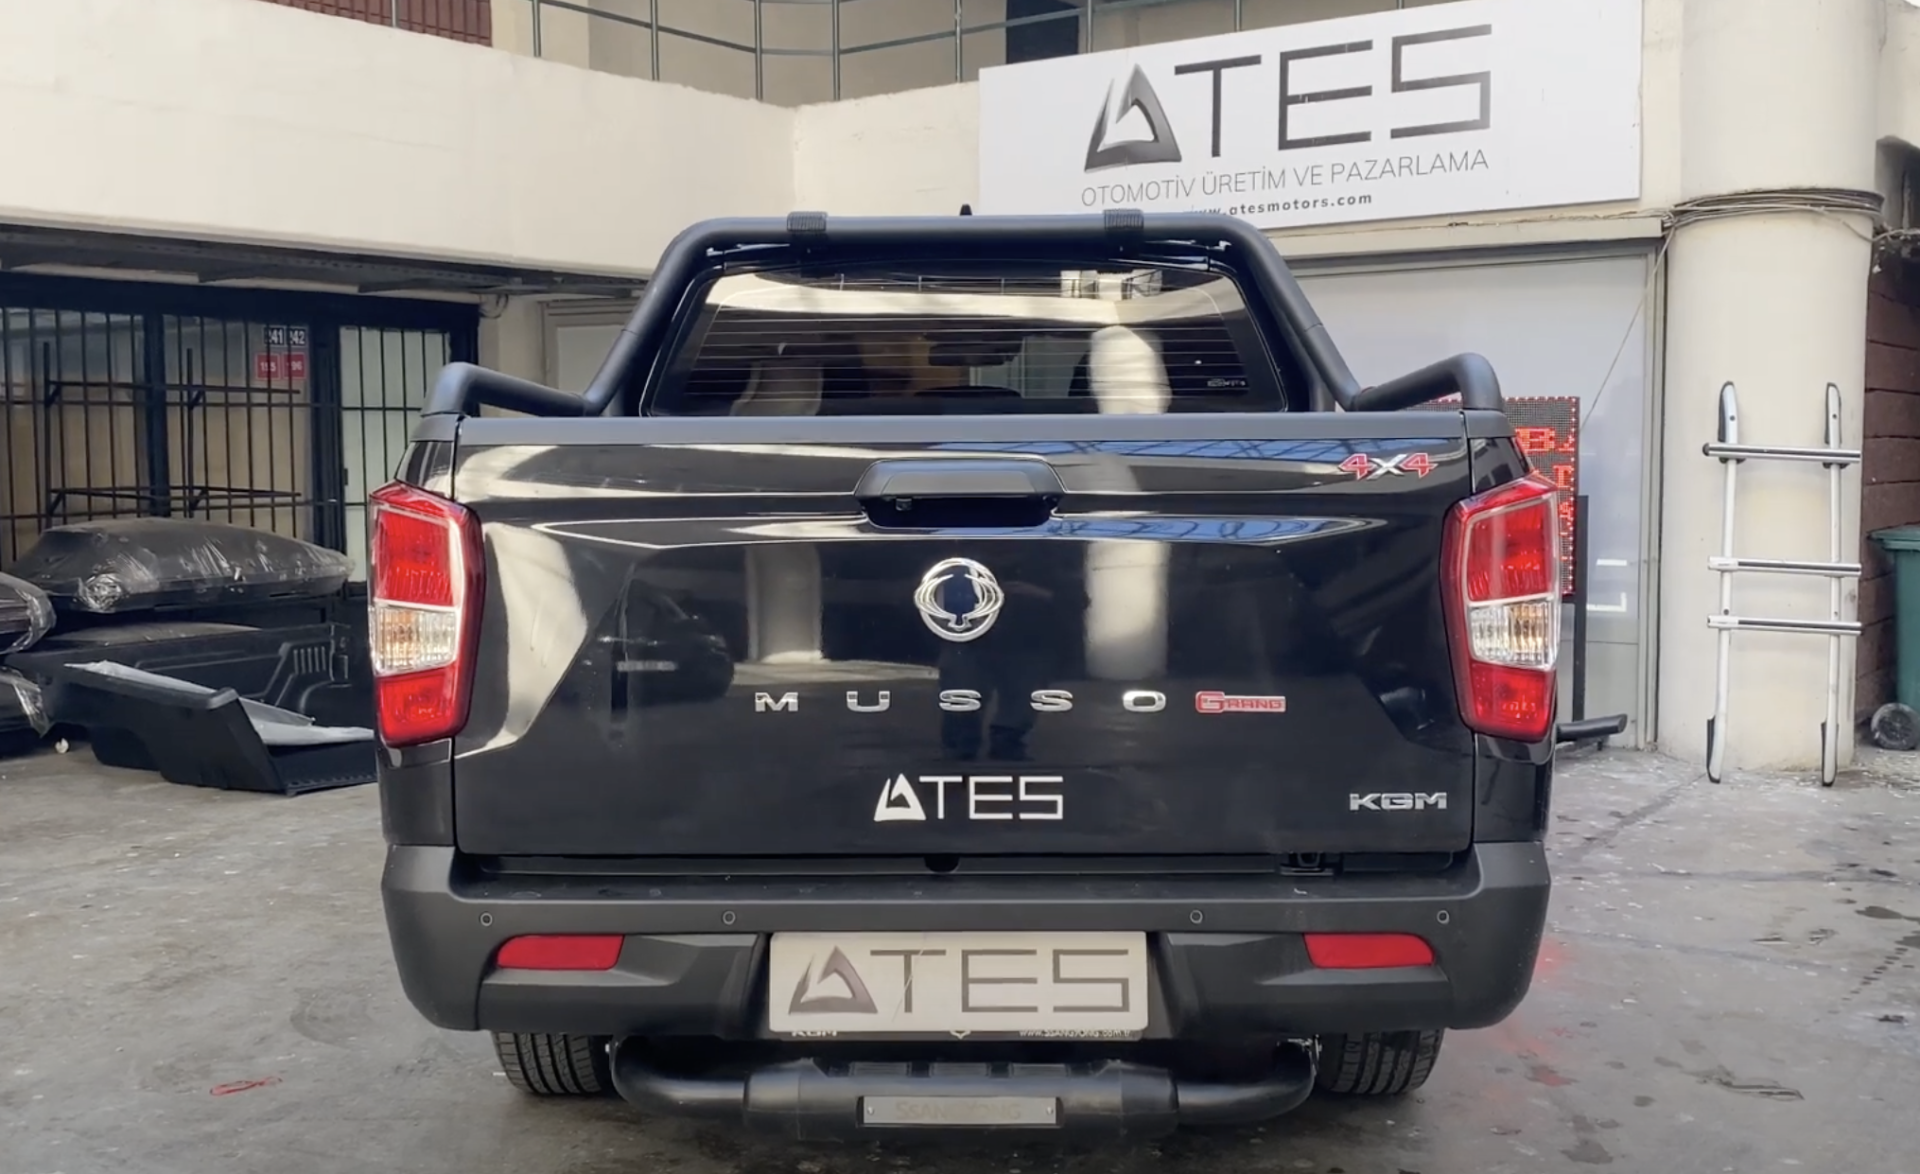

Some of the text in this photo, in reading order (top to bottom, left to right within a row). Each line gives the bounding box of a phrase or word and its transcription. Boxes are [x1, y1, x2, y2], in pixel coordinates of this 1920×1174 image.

[1085, 24, 1491, 170] ATES
[1081, 149, 1489, 206] OTOMOTİV ÜRETİM VE PAZARLAMA
[754, 689, 1167, 713] MUSSO
[873, 773, 1064, 822] ATES
[1349, 792, 1447, 810] KGM
[788, 946, 1130, 1014] ATES
